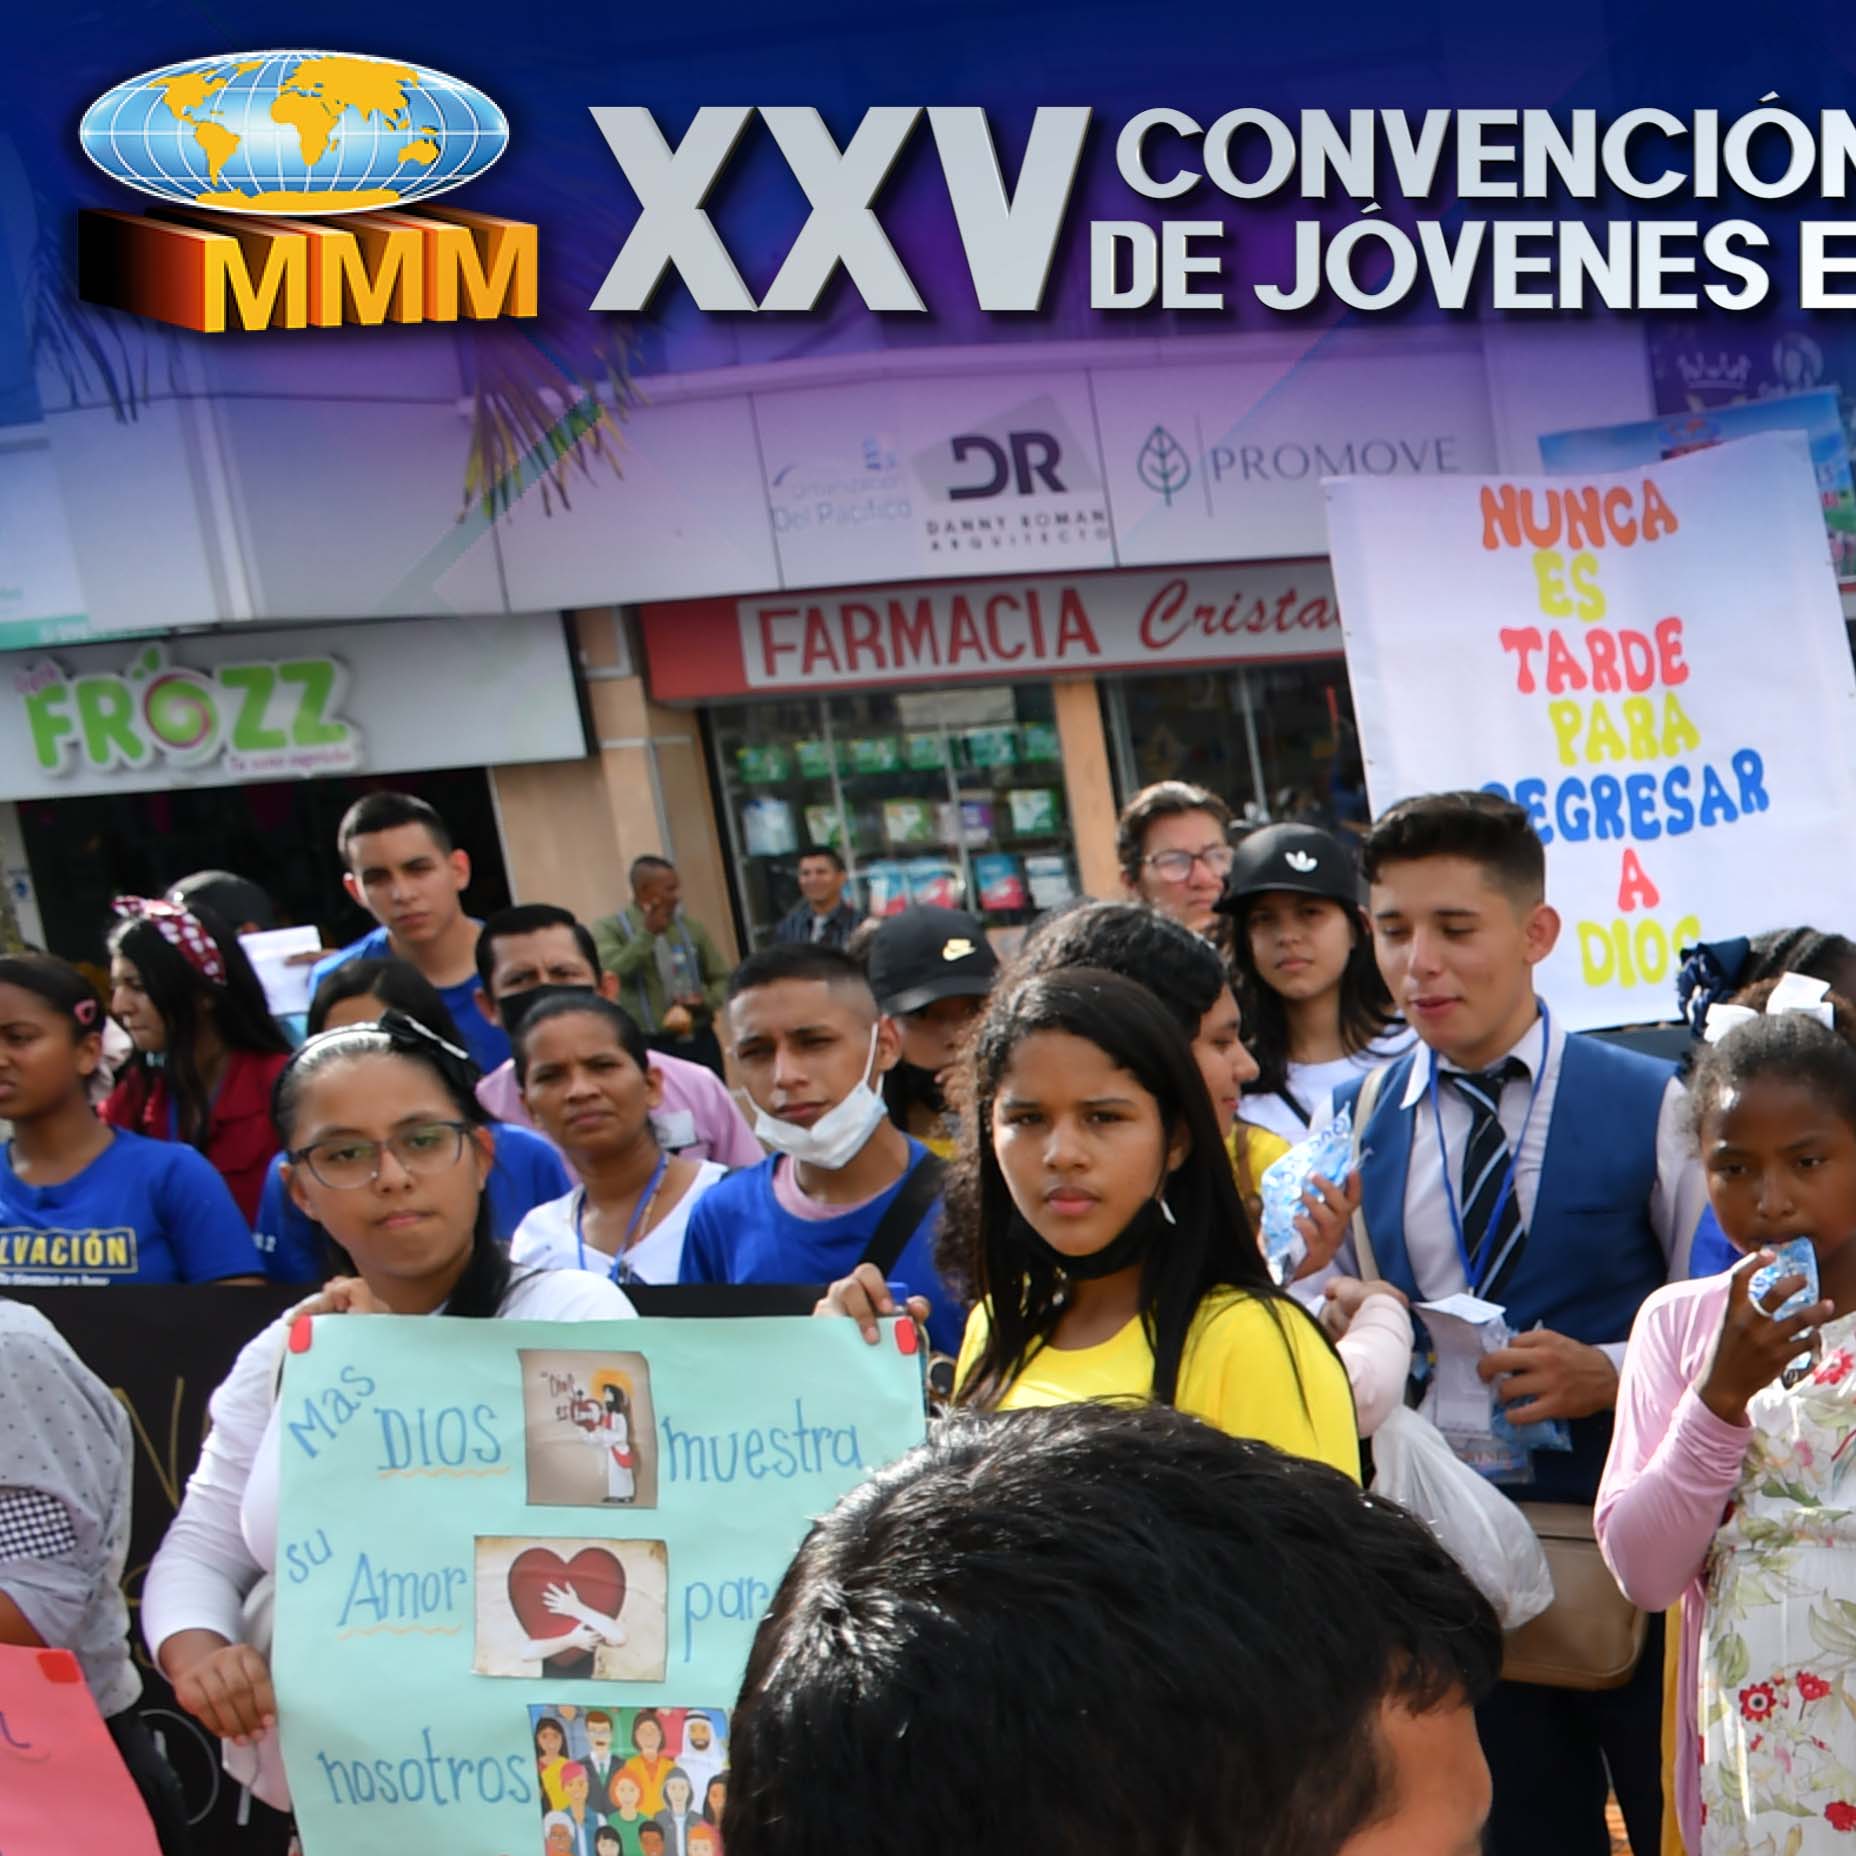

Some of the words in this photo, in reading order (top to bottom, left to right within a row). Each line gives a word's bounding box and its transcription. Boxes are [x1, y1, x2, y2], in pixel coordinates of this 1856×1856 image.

[1212, 436, 1460, 482] PROMOVE
[1480, 478, 1680, 550] NUNCA
[1532, 550, 1608, 622] ES
[757, 587, 1100, 678] FARMACIA
[1138, 577, 1341, 651] Crista
[1500, 616, 1691, 695] TARDE
[24, 659, 348, 769] FROZZ
[1548, 691, 1701, 766] PARA
[1617, 848, 1661, 913] A
[288, 1364, 376, 1459] Mas
[374, 1404, 502, 1472] DIOS
[661, 1397, 863, 1483] muestra
[285, 1528, 333, 1585] su
[337, 1553, 468, 1628] Amor
[317, 1727, 533, 1809] nosotros
